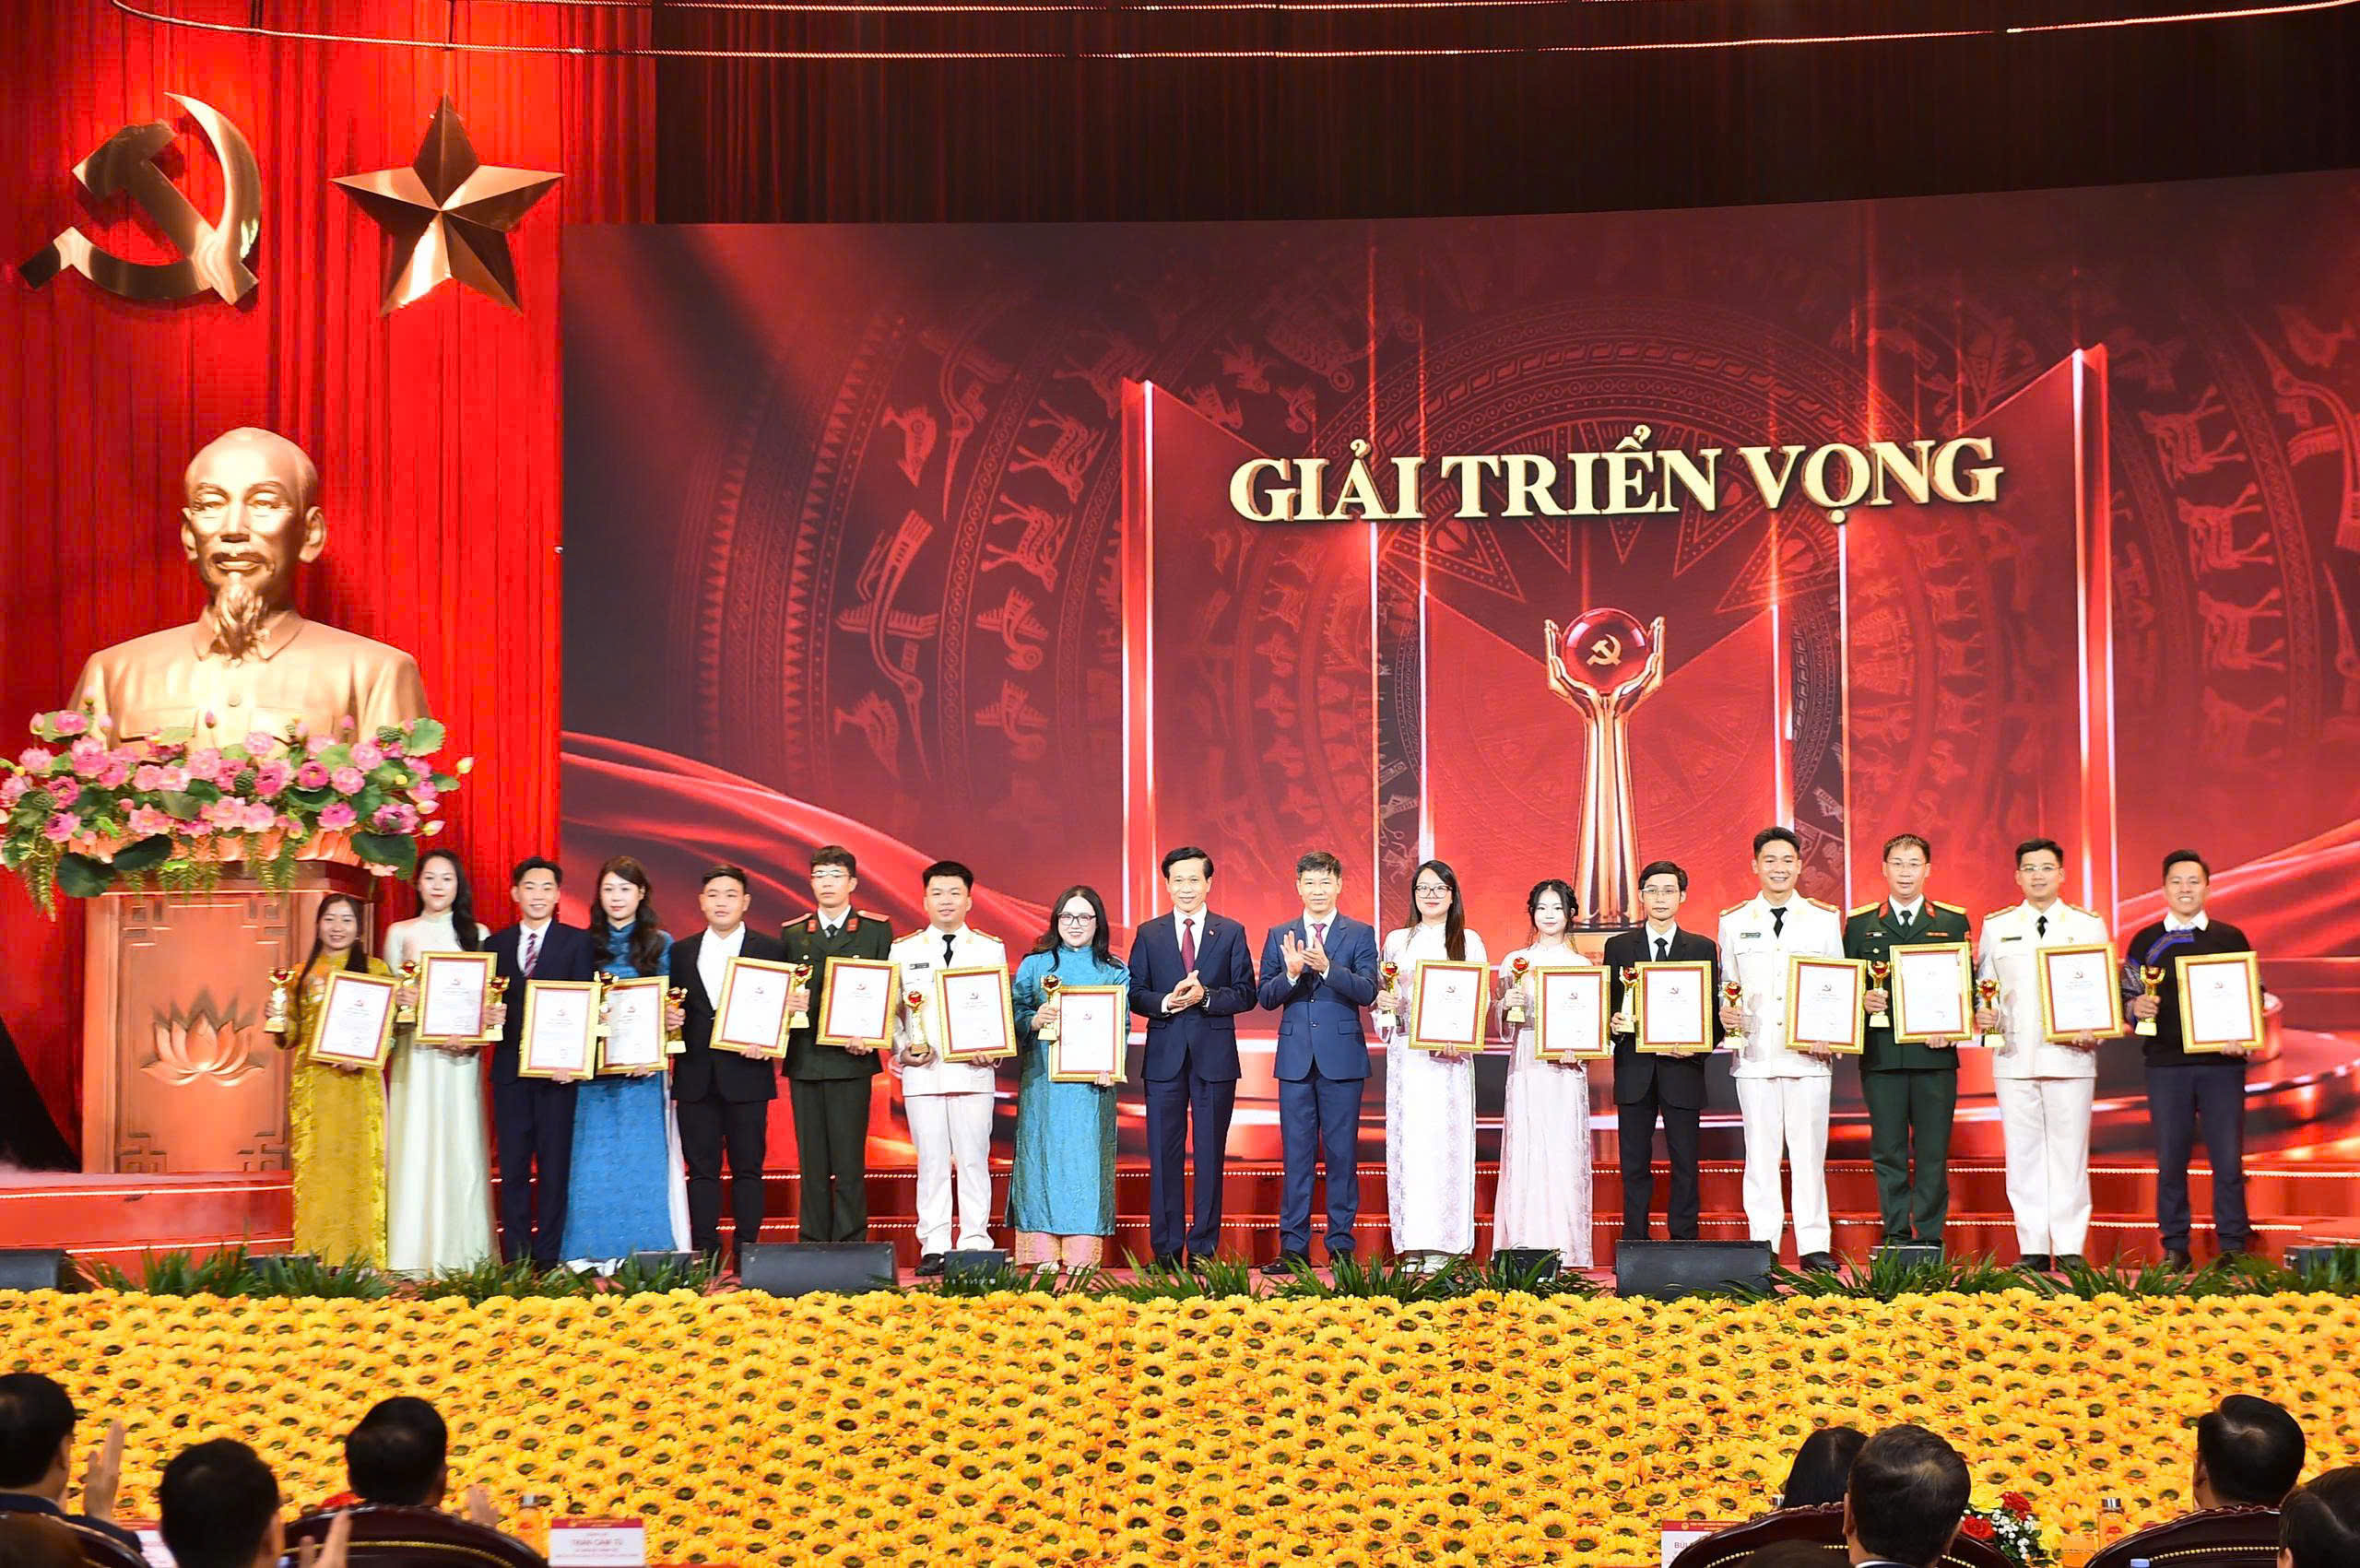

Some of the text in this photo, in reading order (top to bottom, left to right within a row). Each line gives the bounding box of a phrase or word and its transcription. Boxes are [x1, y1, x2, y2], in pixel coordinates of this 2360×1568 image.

[1229, 424, 2004, 525] GIẢI TRIỂN VỌNG
